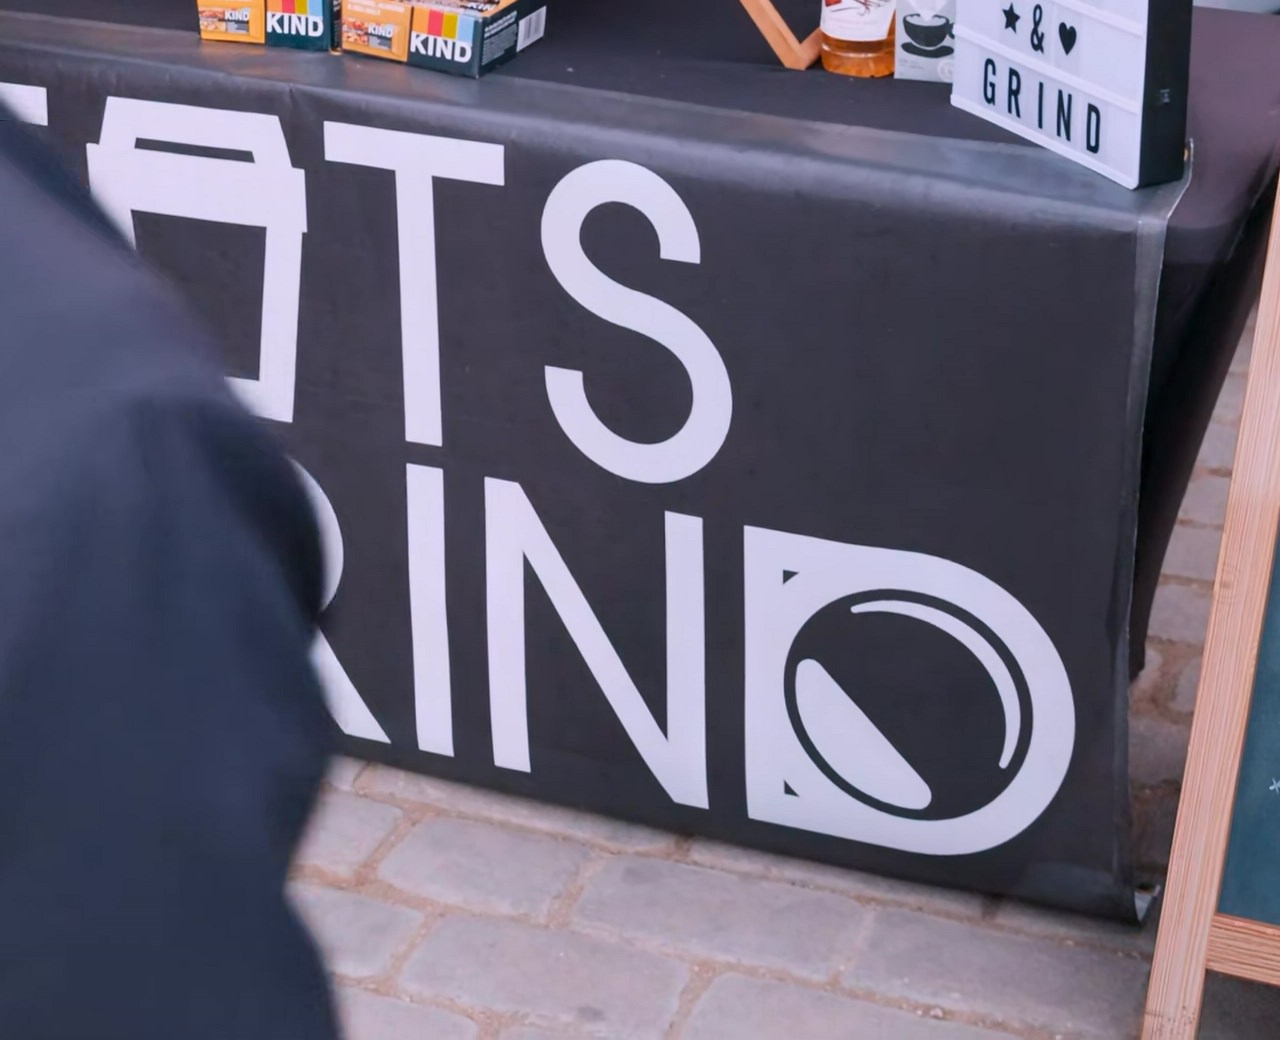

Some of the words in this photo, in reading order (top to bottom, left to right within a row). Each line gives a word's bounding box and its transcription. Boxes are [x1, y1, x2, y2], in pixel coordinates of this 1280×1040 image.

[468, 1, 496, 11] KIN
[267, 11, 324, 37] KIND
[1030, 3, 1045, 54] &
[410, 33, 472, 63] KIND
[983, 57, 1101, 154] GRIND
